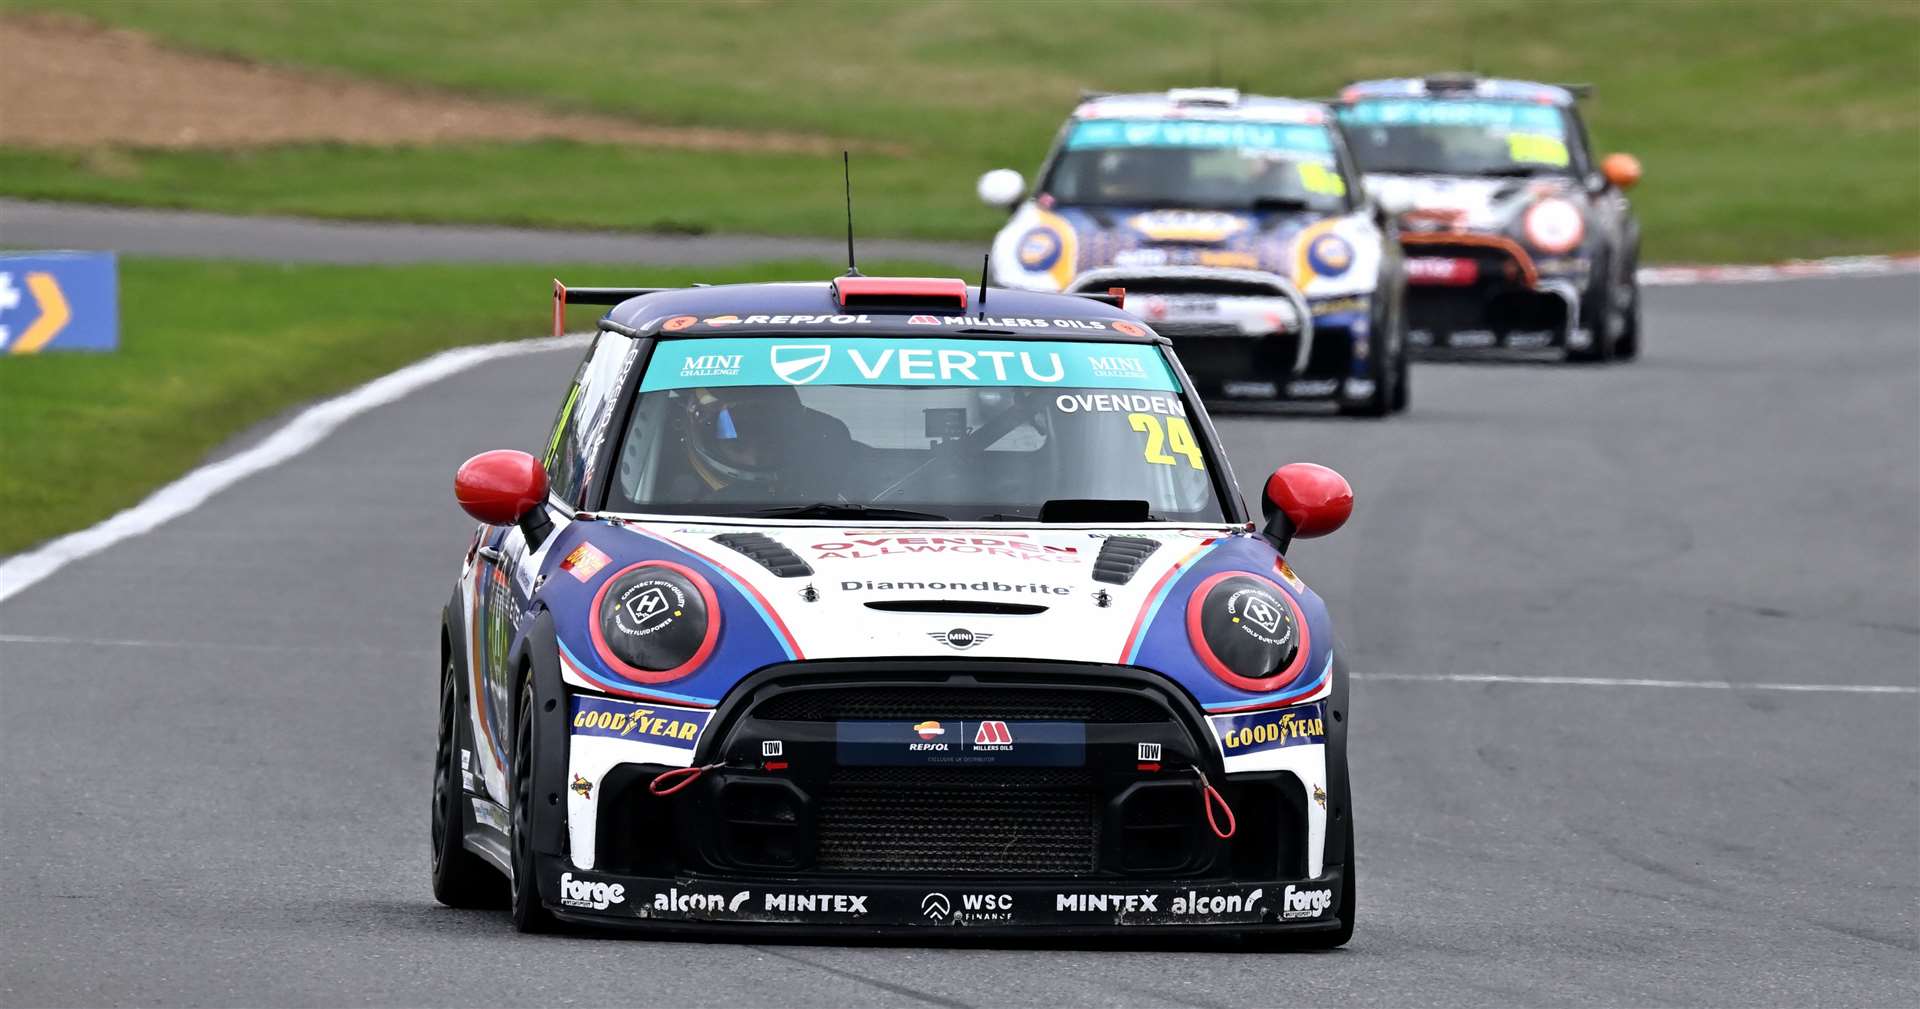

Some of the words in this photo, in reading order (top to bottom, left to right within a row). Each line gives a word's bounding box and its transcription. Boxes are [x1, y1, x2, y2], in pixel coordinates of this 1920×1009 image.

[743, 314, 872, 325] REPSOL
[944, 315, 1050, 328] MILLERS
[1053, 319, 1106, 330] OILS
[683, 354, 744, 370] MINI
[848, 347, 1065, 382] VERTU
[1088, 356, 1146, 373] MINI
[680, 368, 740, 377] CHALLENGE
[1056, 393, 1186, 416] OVENDEN
[1128, 412, 1205, 471] 24
[811, 537, 1078, 554] OVENDEN
[818, 545, 1082, 563] ALLWORKS
[841, 580, 1071, 596] Diamondbrite
[949, 633, 972, 642] MINI
[764, 742, 780, 755] TOW
[909, 743, 949, 751] REPSOL
[1140, 744, 1160, 760] TOW
[560, 872, 625, 910] forge
[654, 888, 724, 911] alcon
[765, 893, 868, 913] MINTEX
[962, 894, 1013, 910] WSC
[1056, 893, 1159, 913] MINTEX
[1171, 891, 1241, 914] alcon
[1283, 884, 1332, 917] forge
